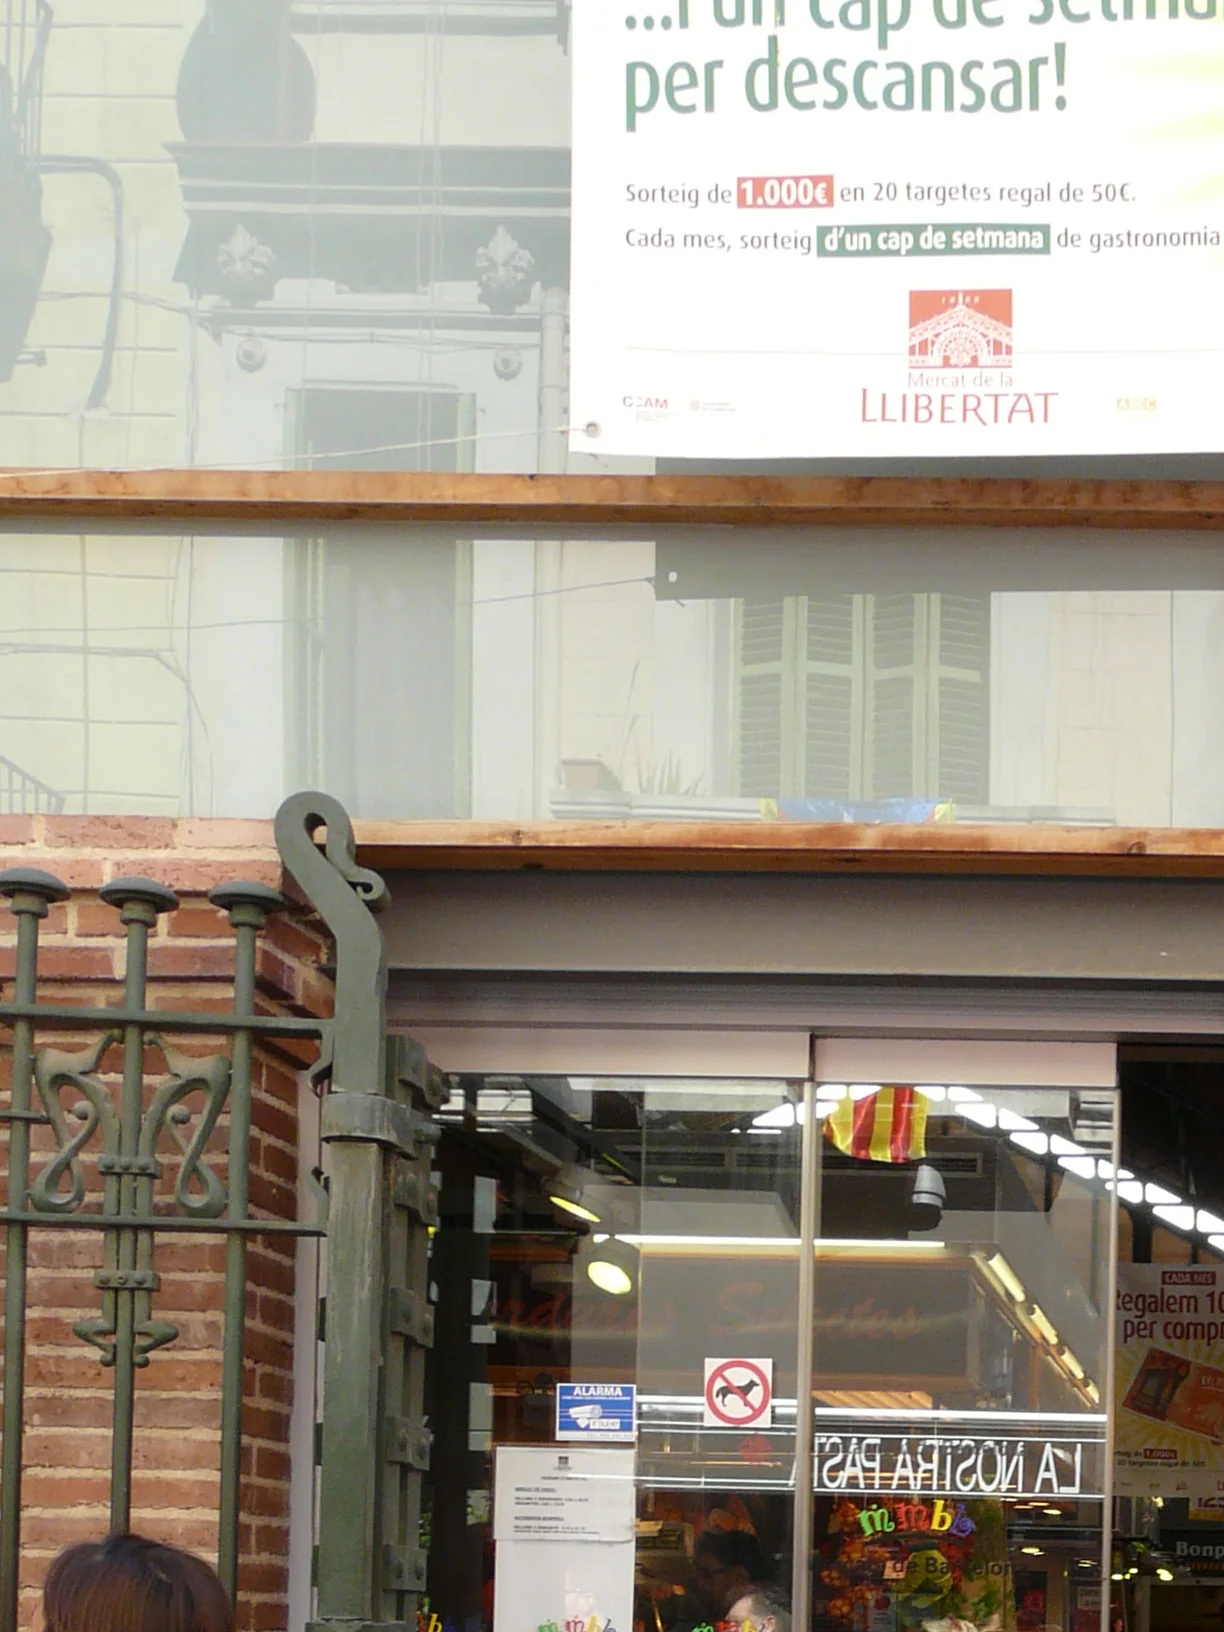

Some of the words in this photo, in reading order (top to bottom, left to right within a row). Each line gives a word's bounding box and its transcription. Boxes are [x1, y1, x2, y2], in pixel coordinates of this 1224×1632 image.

[808, 0, 911, 51] cap
[625, 60, 724, 132] per
[745, 34, 1067, 113] descansar!
[626, 183, 699, 209] Sorteig
[707, 181, 732, 204] de
[740, 178, 828, 207] 1.000€
[840, 185, 865, 202] en
[873, 181, 897, 202] 20
[906, 181, 991, 206] targetes
[999, 181, 1051, 207] regal
[1058, 181, 1084, 203] de
[1092, 183, 1136, 203] 50€.
[625, 228, 675, 249] Cada
[683, 232, 732, 253] mes,
[739, 230, 812, 256] sorteig
[877, 229, 914, 255] cap
[918, 225, 946, 250] de
[952, 225, 1043, 250] setmana
[1056, 227, 1083, 248] de
[1089, 225, 1220, 253] gastronomia
[907, 372, 966, 388] Mercat
[973, 371, 995, 388] de
[1000, 371, 1013, 388] la
[860, 388, 1059, 426] LLIBERTAT
[1165, 1272, 1191, 1284] CADA
[1123, 1319, 1158, 1344] per
[573, 1386, 623, 1397] ALARMA
